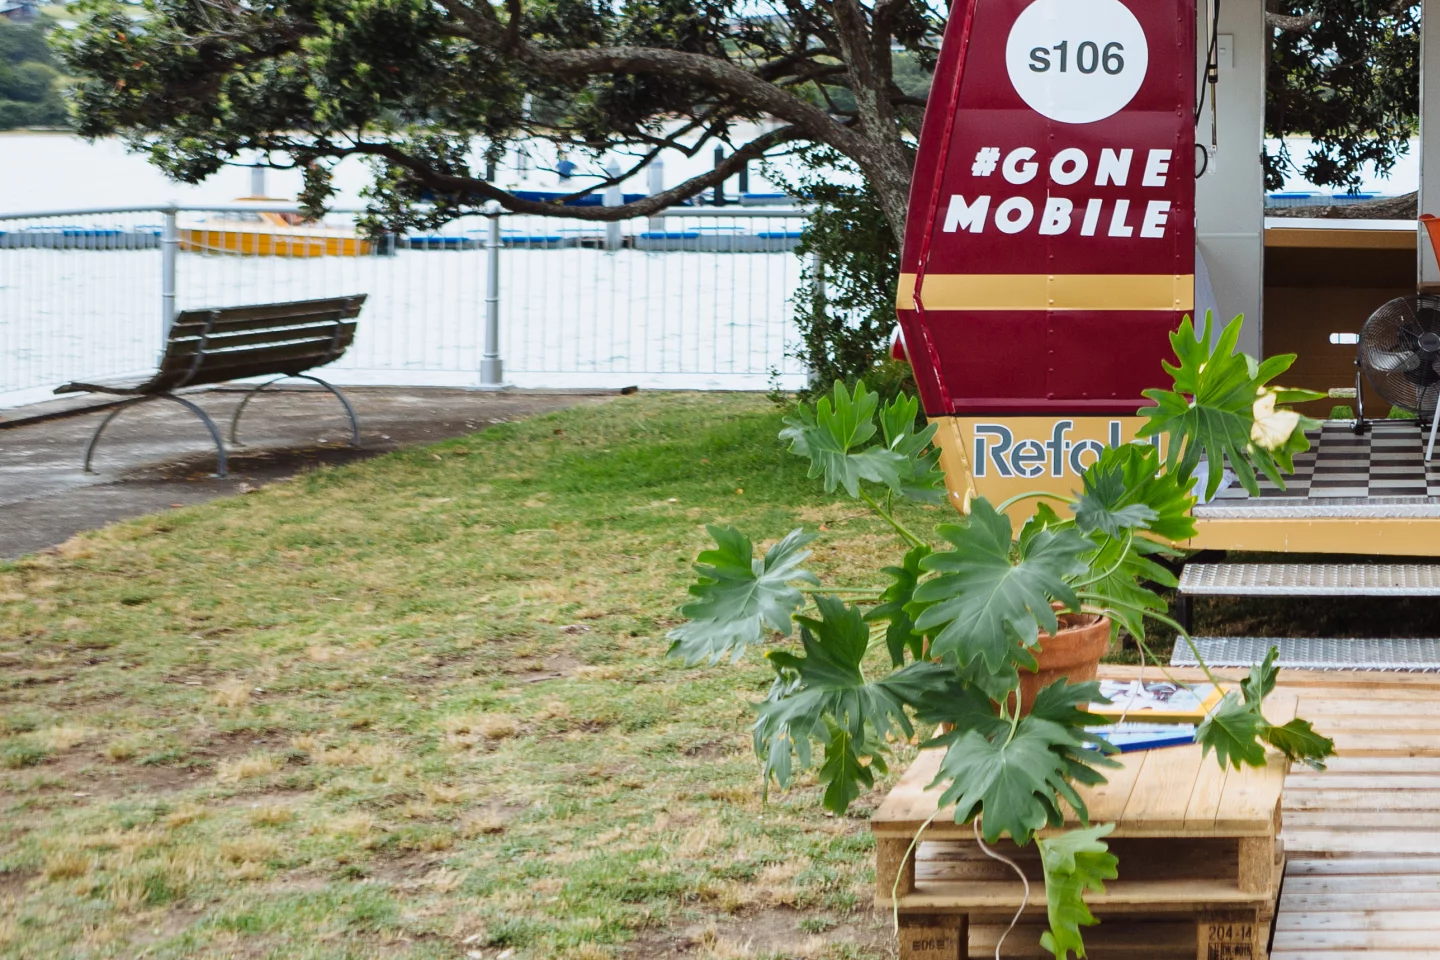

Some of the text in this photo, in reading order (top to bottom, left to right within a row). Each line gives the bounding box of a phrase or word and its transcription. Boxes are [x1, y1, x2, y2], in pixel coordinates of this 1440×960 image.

[1028, 40, 1125, 75] s106
[971, 146, 1173, 188] #GONE
[942, 194, 1172, 239] MOBILE
[973, 419, 1162, 479] Refol
